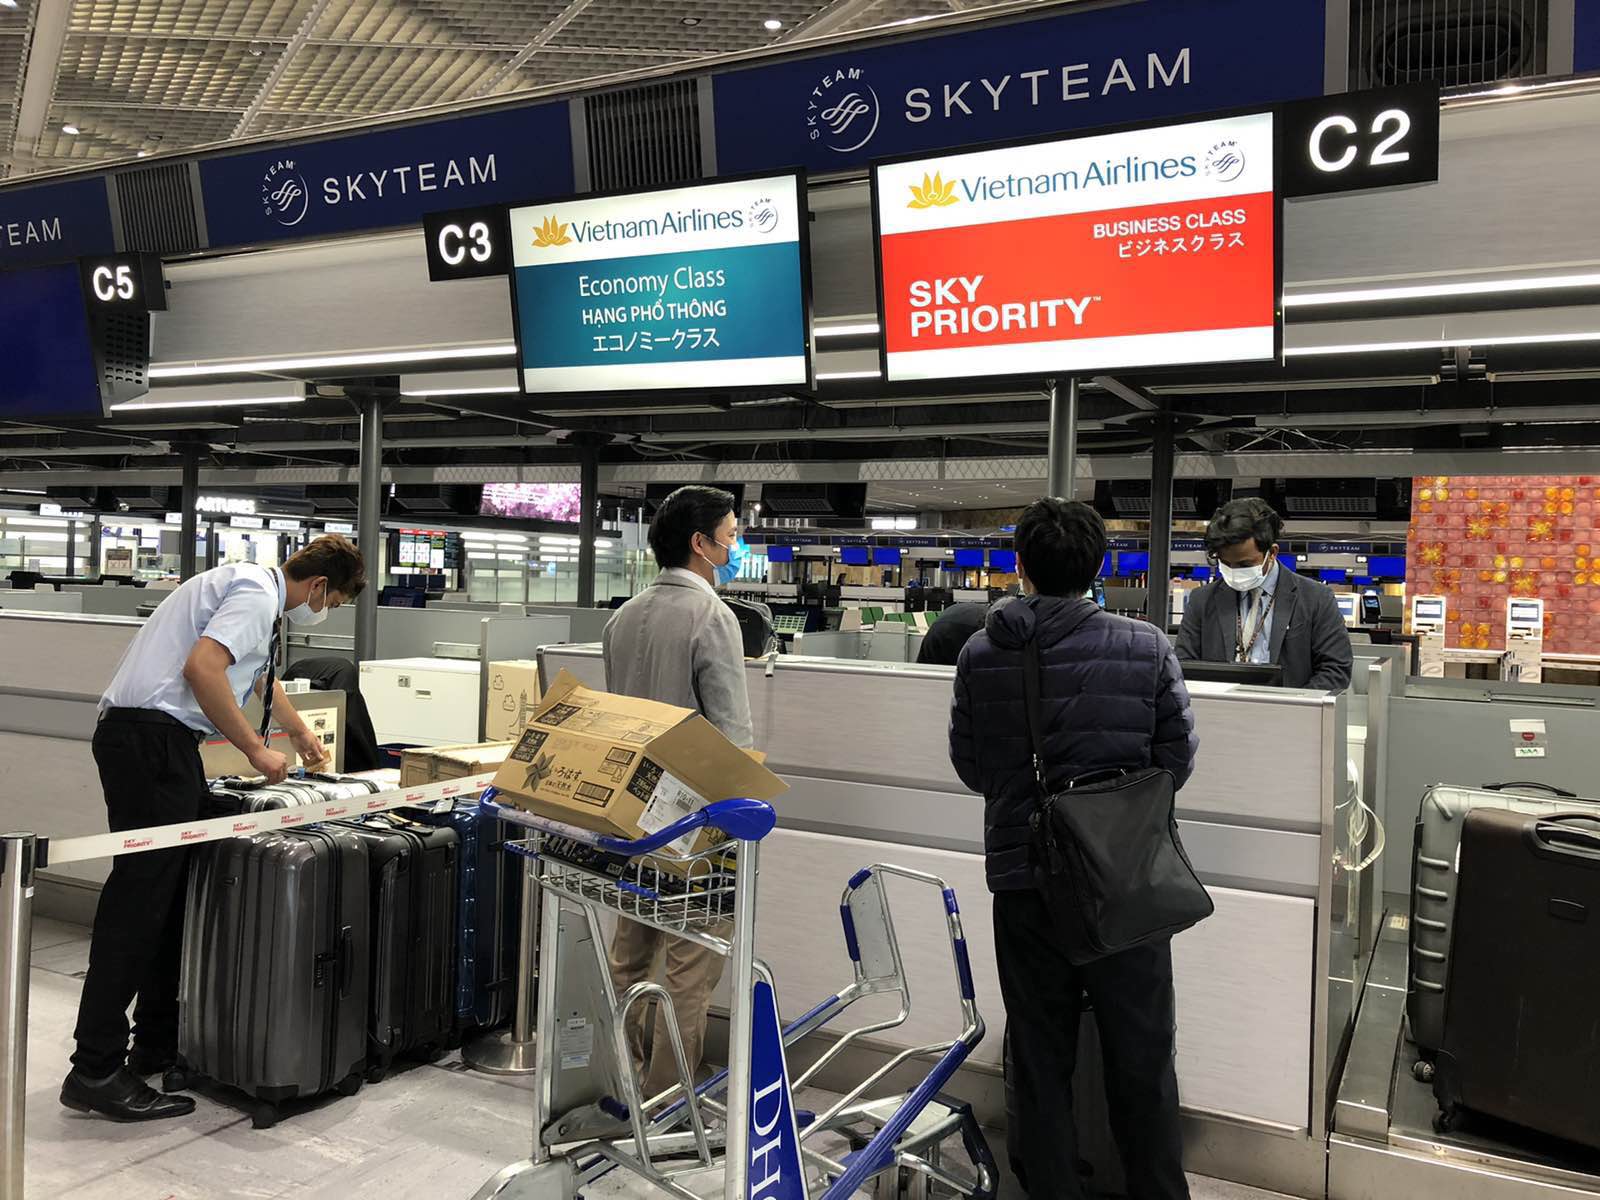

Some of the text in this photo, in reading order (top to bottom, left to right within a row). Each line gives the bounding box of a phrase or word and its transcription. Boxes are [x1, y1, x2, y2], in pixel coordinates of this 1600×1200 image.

[807, 67, 864, 140] SKYTEAM
[905, 48, 1190, 122] SKYTEAM
[1309, 109, 1411, 172] C2
[262, 160, 294, 216] SKYTEAM
[323, 153, 497, 204] SKYTEAM
[961, 155, 1197, 202] Vietnam Airlines
[571, 207, 744, 243] Vietnam Airlines
[1093, 208, 1247, 239] BUSINESS CLASS
[438, 222, 492, 265] C3
[1118, 231, 1245, 258] ビジネスクラス
[92, 265, 134, 301] C5
[579, 265, 726, 297] Economy Class
[909, 275, 984, 307] SKY
[582, 306, 627, 329] HẠNG
[666, 299, 728, 320] THÔNG
[592, 327, 721, 353] エコノミークラス
[751, 1073, 784, 1200] DH
